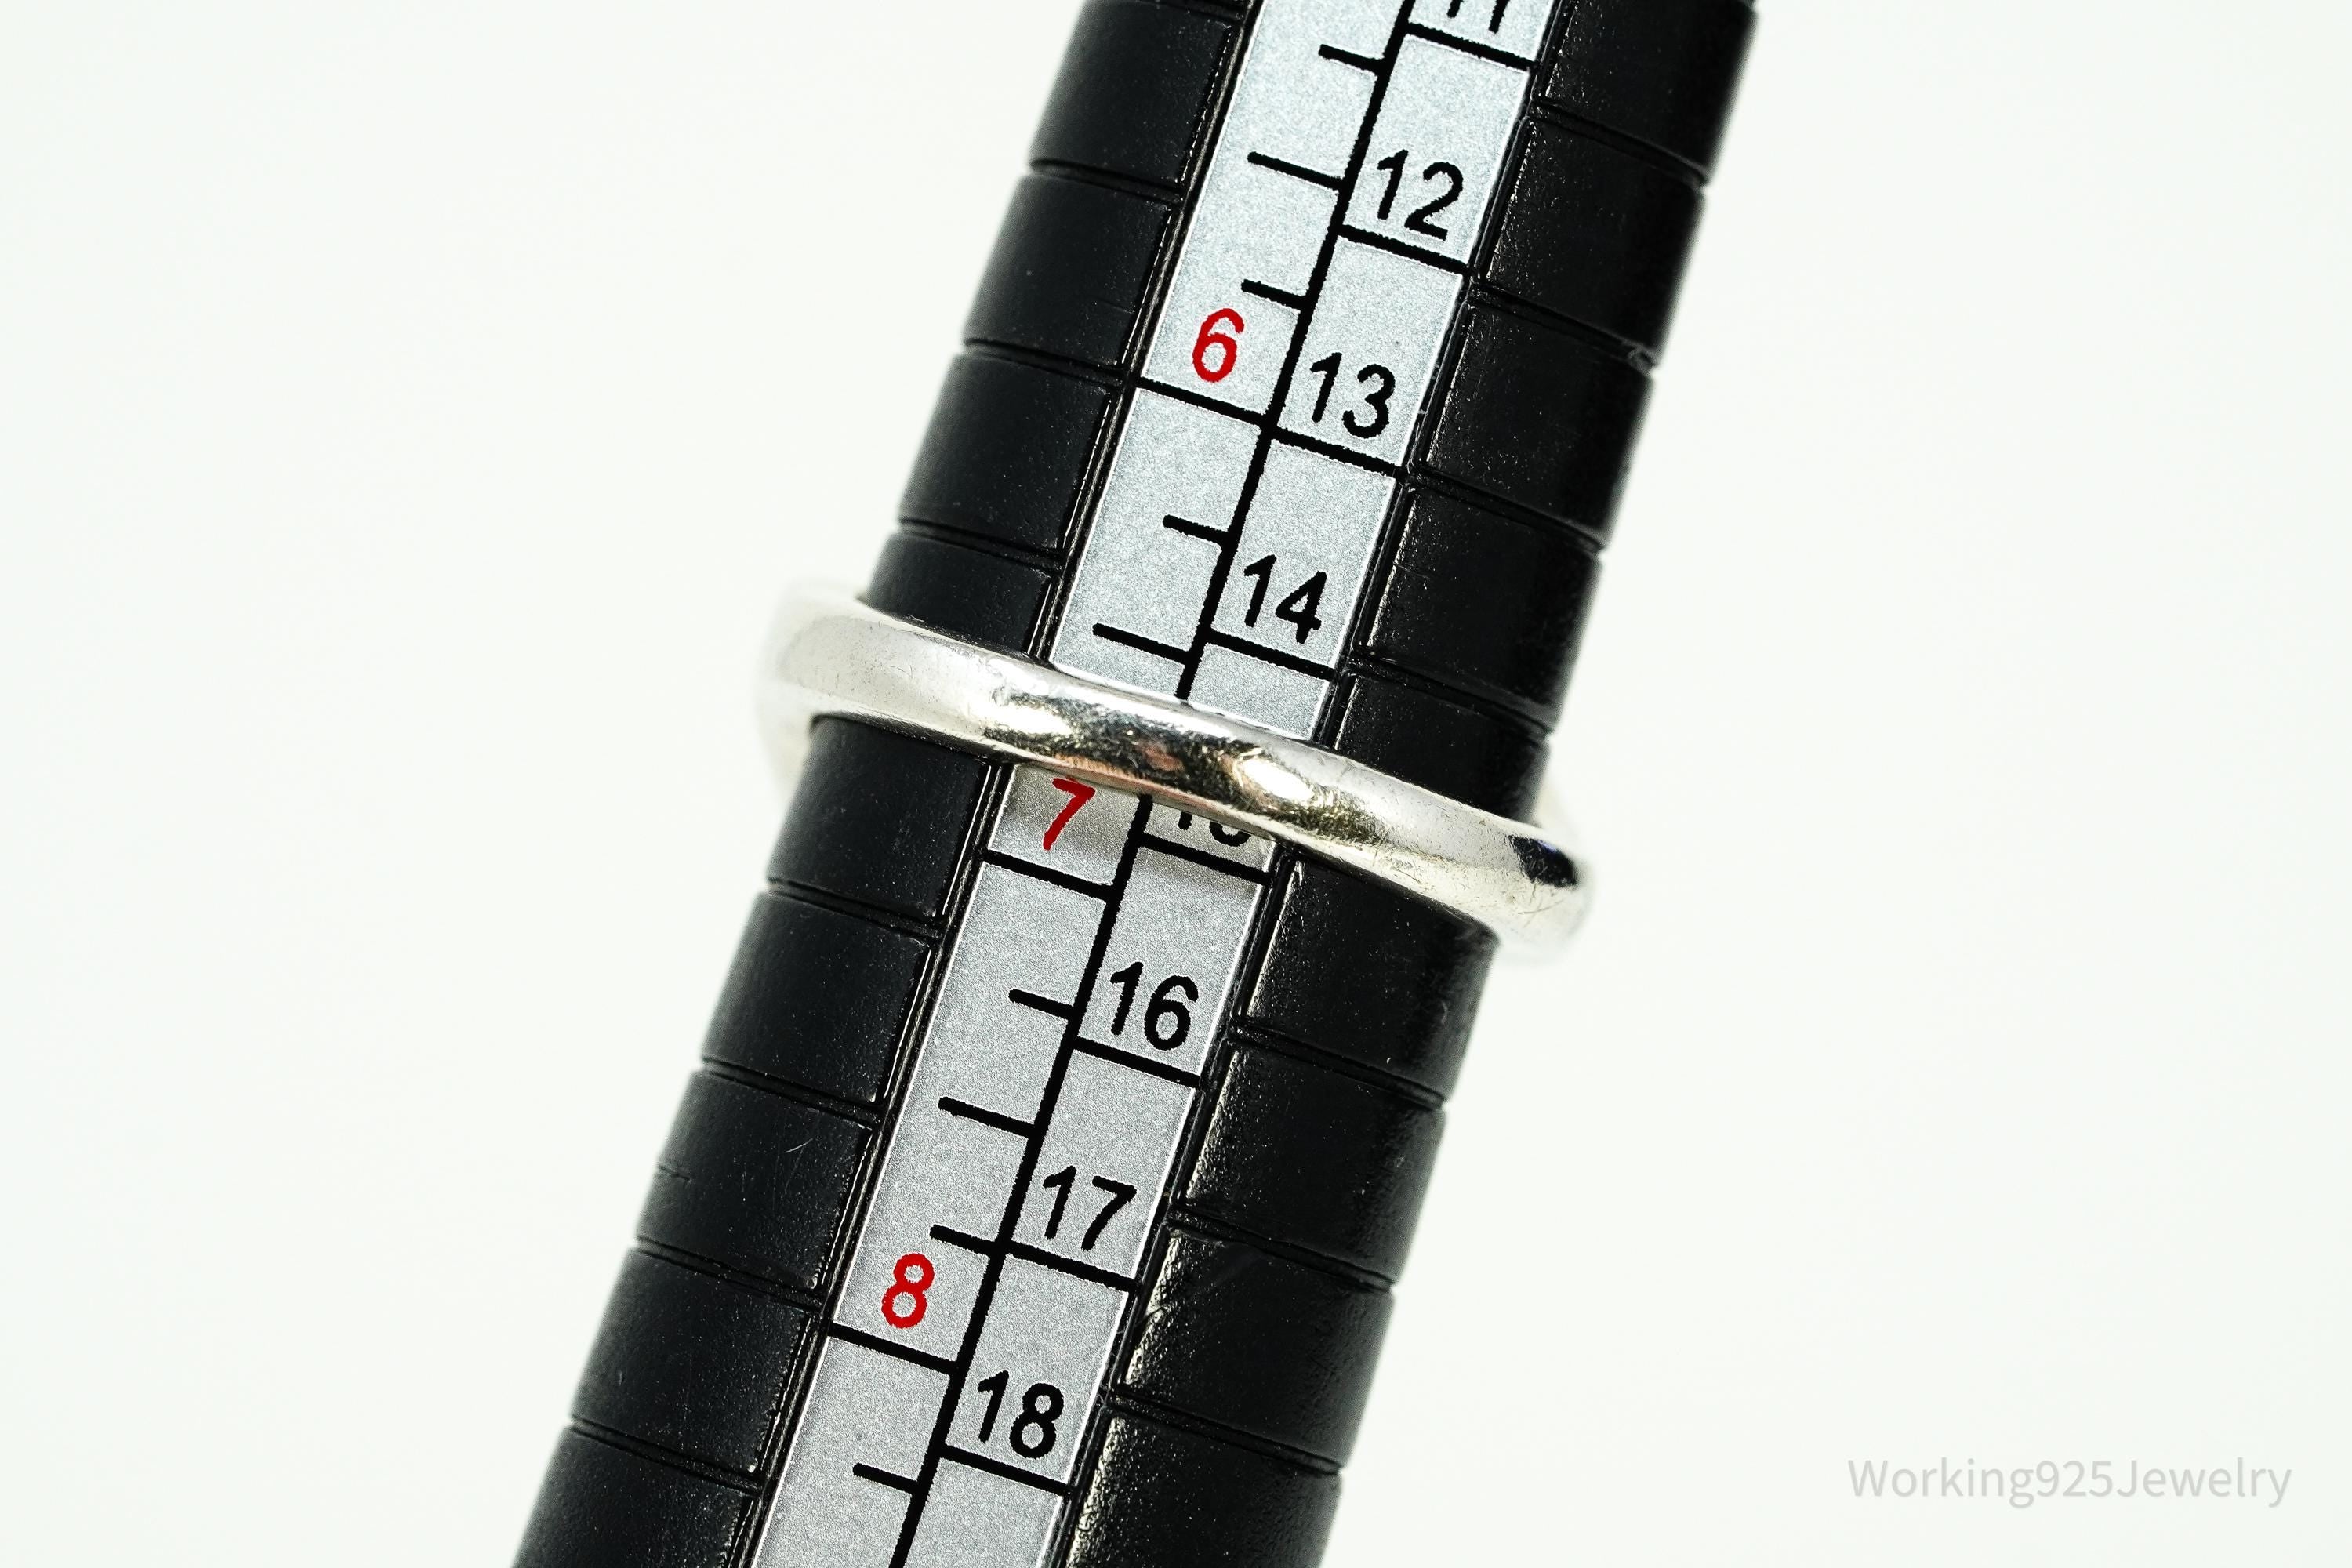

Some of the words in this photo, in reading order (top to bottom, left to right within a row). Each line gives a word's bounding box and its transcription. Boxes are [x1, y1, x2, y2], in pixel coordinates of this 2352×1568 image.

[1377, 149, 1465, 242] 12
[1192, 308, 1245, 384] 6
[1309, 352, 1396, 440] 13
[1243, 554, 1328, 645] 14
[1044, 776, 1096, 851] 7
[1109, 961, 1200, 1051] 16
[1042, 1165, 1138, 1252] 17
[880, 1252, 935, 1330] 8
[977, 1370, 1065, 1461] 18
